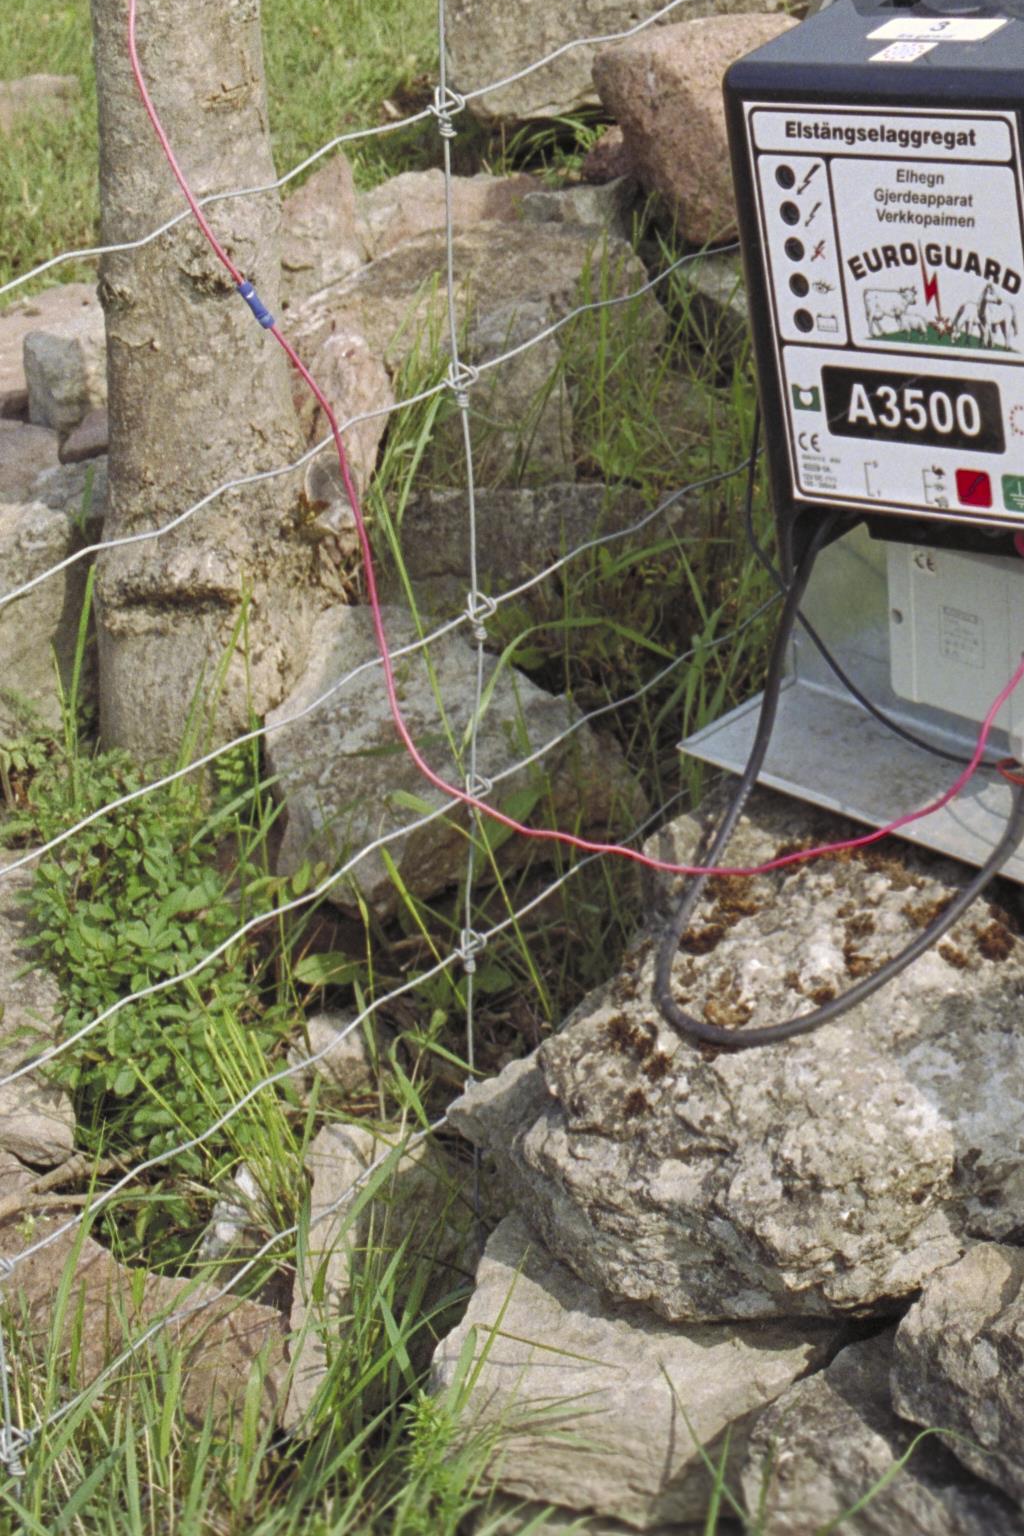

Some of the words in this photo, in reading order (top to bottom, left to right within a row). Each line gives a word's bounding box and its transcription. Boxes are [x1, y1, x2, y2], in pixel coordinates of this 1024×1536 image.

[785, 121, 976, 147] Elstängselaggregat
[896, 169, 945, 186] Elhegn
[874, 188, 973, 209] Gjerdeapparat
[876, 207, 975, 228] Verkkopaimen
[848, 383, 982, 436] A3500
[798, 432, 820, 453] CE
